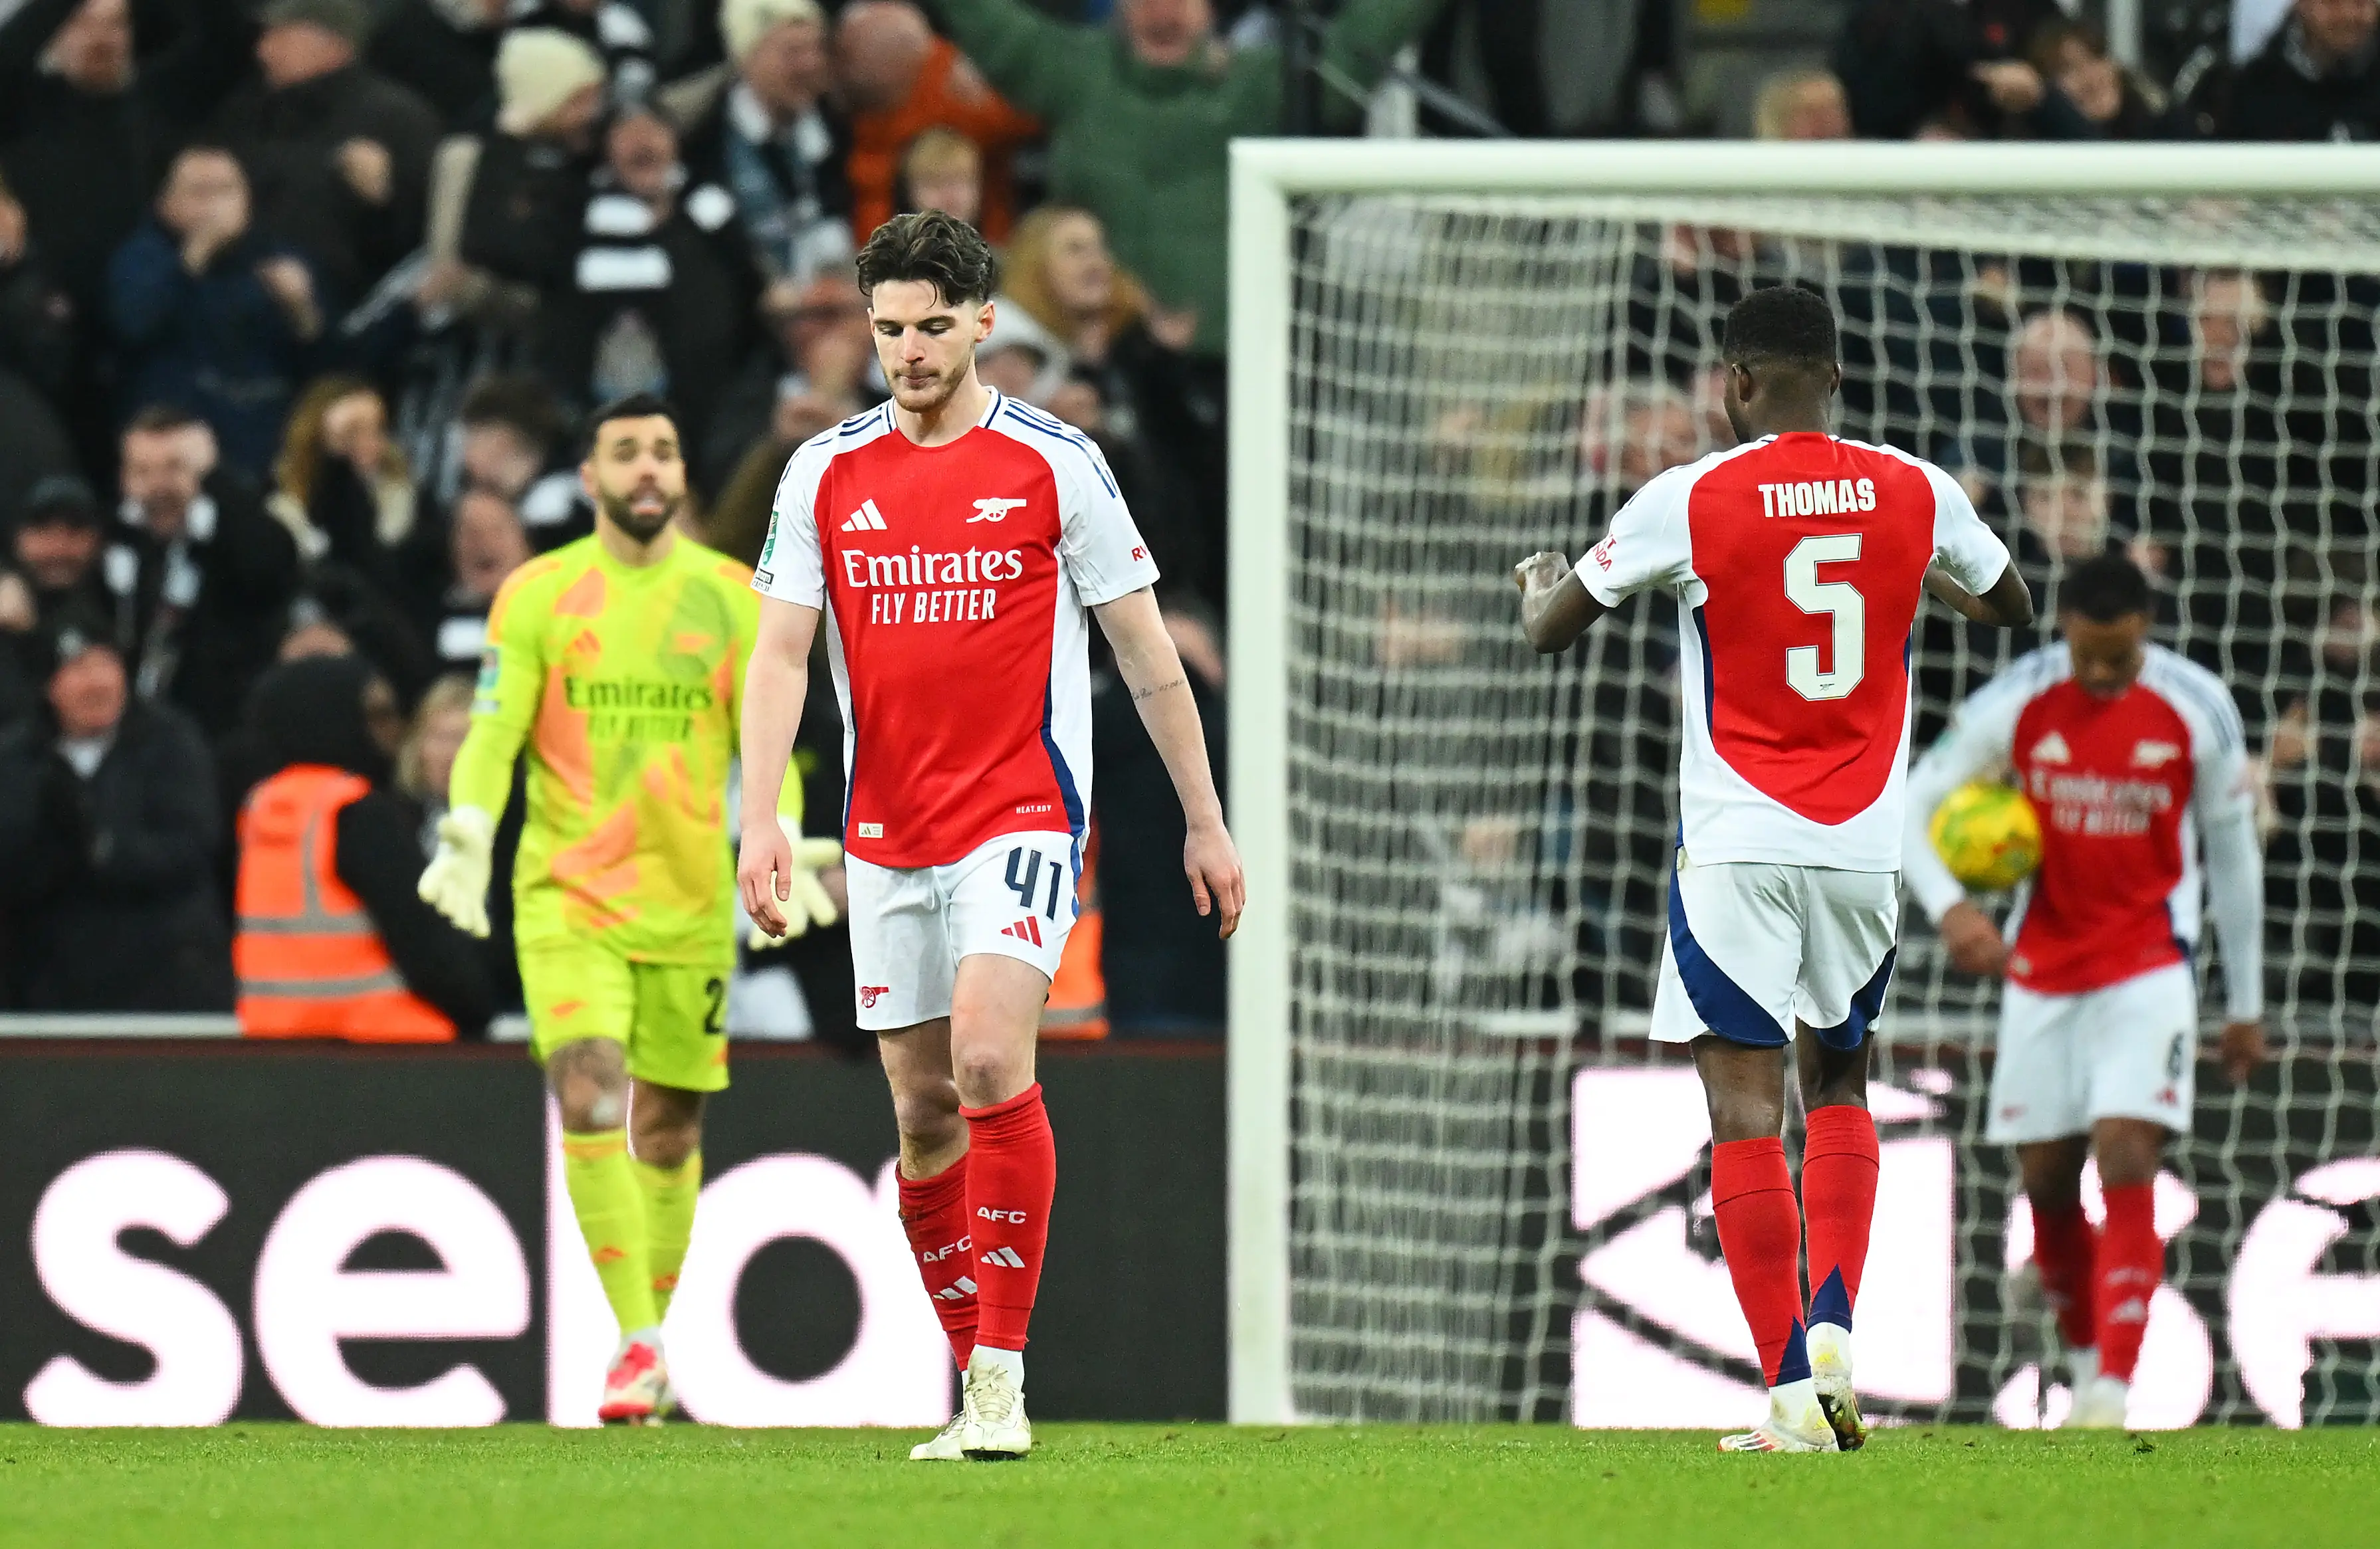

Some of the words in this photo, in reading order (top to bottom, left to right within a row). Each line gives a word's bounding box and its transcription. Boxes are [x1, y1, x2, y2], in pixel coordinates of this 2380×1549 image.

[1758, 478, 1876, 518] THOMAS
[841, 545, 1023, 587] Emirates
[872, 593, 906, 625] FLY
[913, 589, 996, 623] BETTER
[1783, 533, 1864, 701] 5
[1004, 846, 1062, 921] 41
[976, 1207, 1027, 1225] AFC
[923, 1235, 973, 1264] AFC
